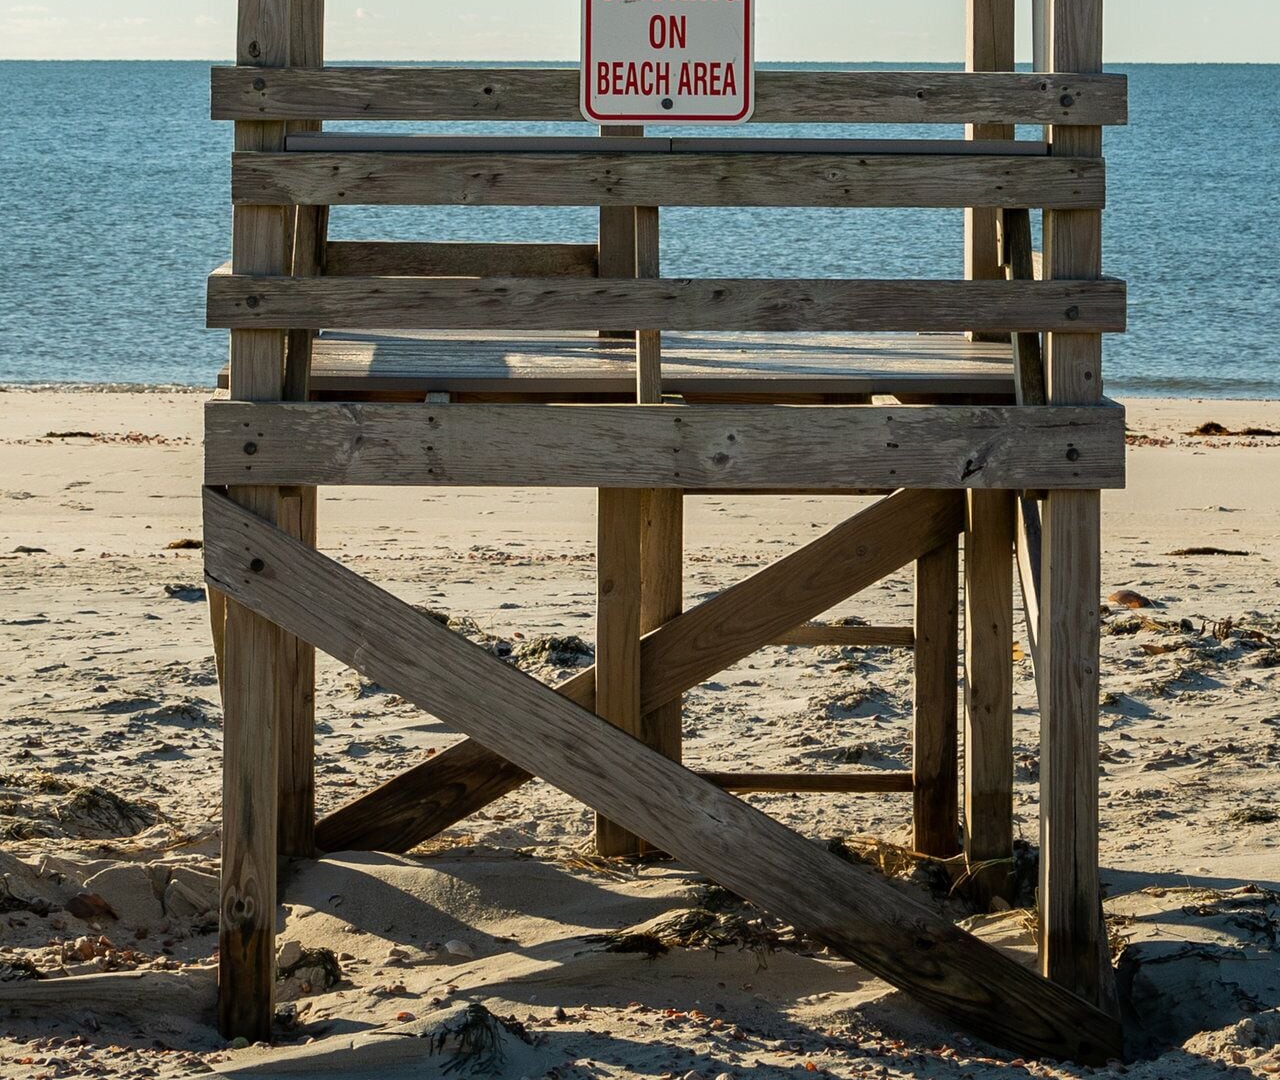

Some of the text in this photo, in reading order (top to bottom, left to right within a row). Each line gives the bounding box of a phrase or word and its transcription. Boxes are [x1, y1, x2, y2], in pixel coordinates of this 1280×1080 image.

[649, 14, 687, 49] ON
[597, 61, 737, 96] BEACH AREA
